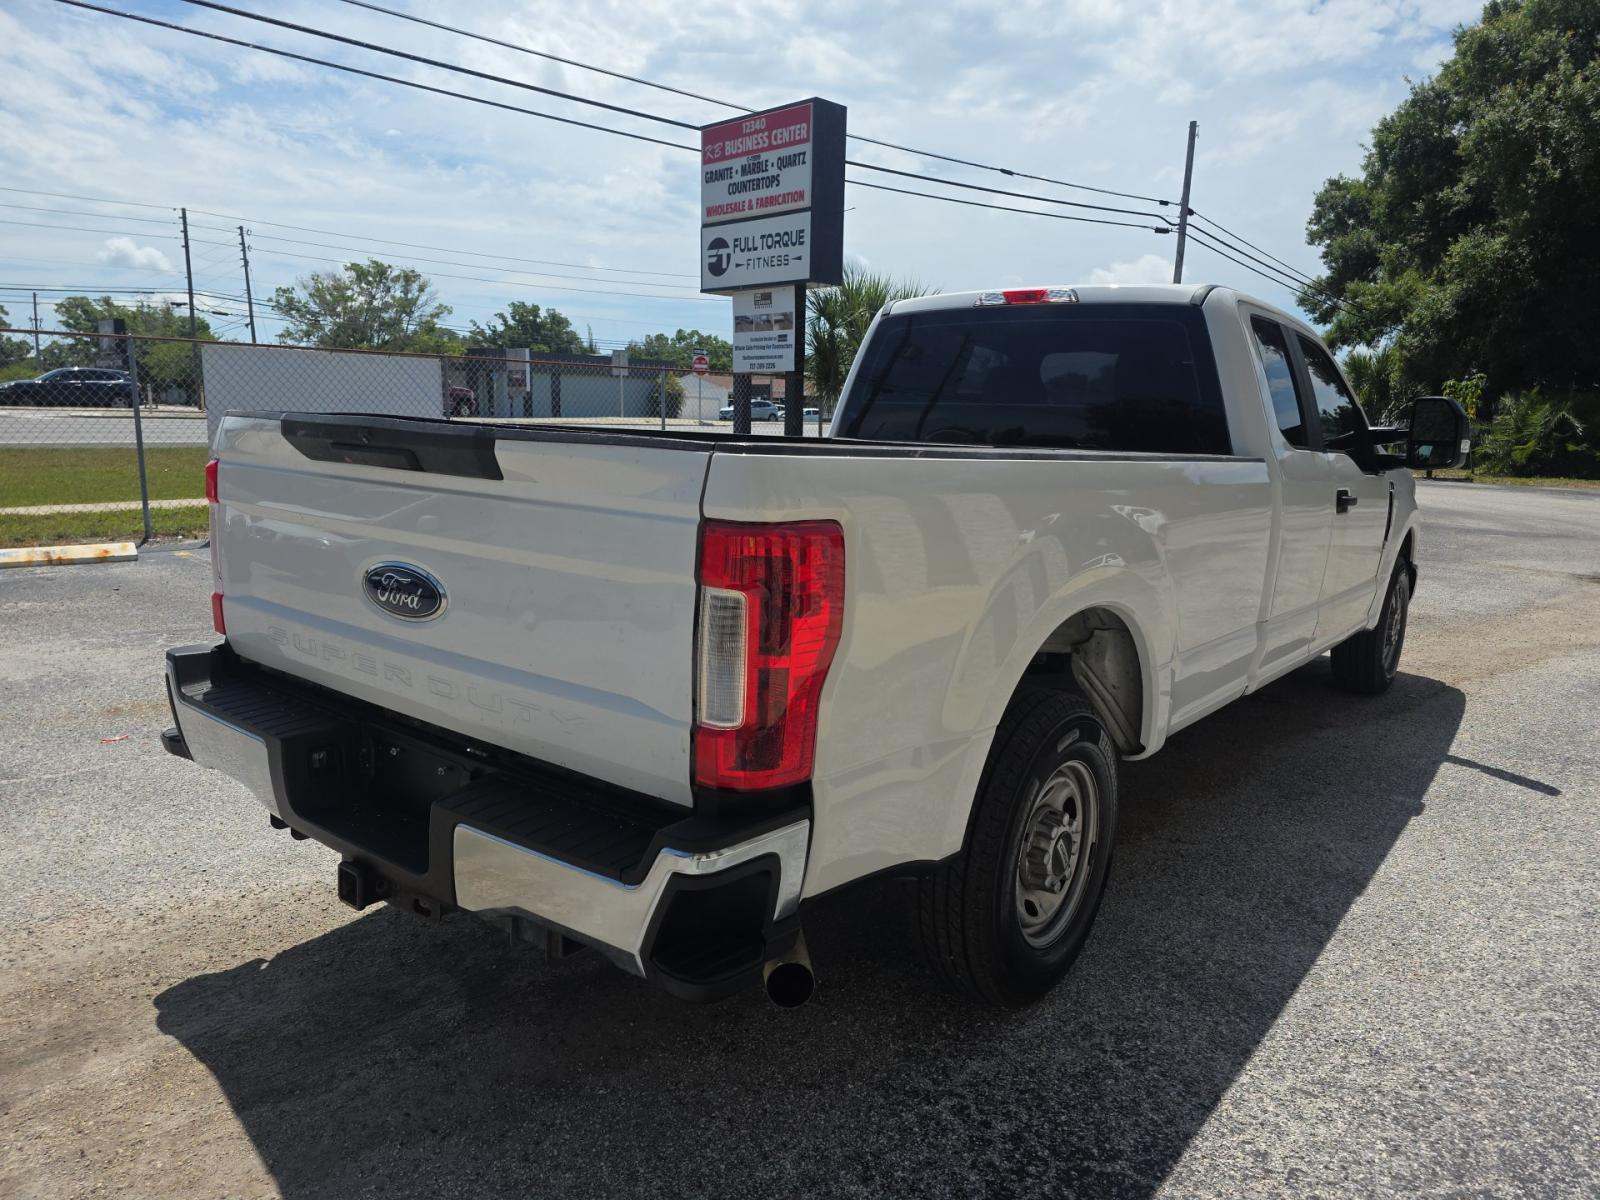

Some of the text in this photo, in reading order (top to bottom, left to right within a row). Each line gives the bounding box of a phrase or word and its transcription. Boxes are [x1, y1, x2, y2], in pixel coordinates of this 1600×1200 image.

[725, 131, 769, 156] BUSINESS
[771, 123, 807, 146] CENTER
[742, 118, 766, 134] 12340
[704, 166, 733, 184] GRANITE
[740, 159, 769, 177] MARBLE
[776, 151, 807, 172] QUARTZ
[728, 174, 781, 195] COUNTERTOPS
[705, 190, 805, 217] WHOLESALE & FABRICATION
[733, 229, 805, 253] FULL TORQUE
[746, 254, 789, 270] FITNESS
[377, 572, 423, 610] Ford
[268, 625, 585, 736] SUPER DUTY
